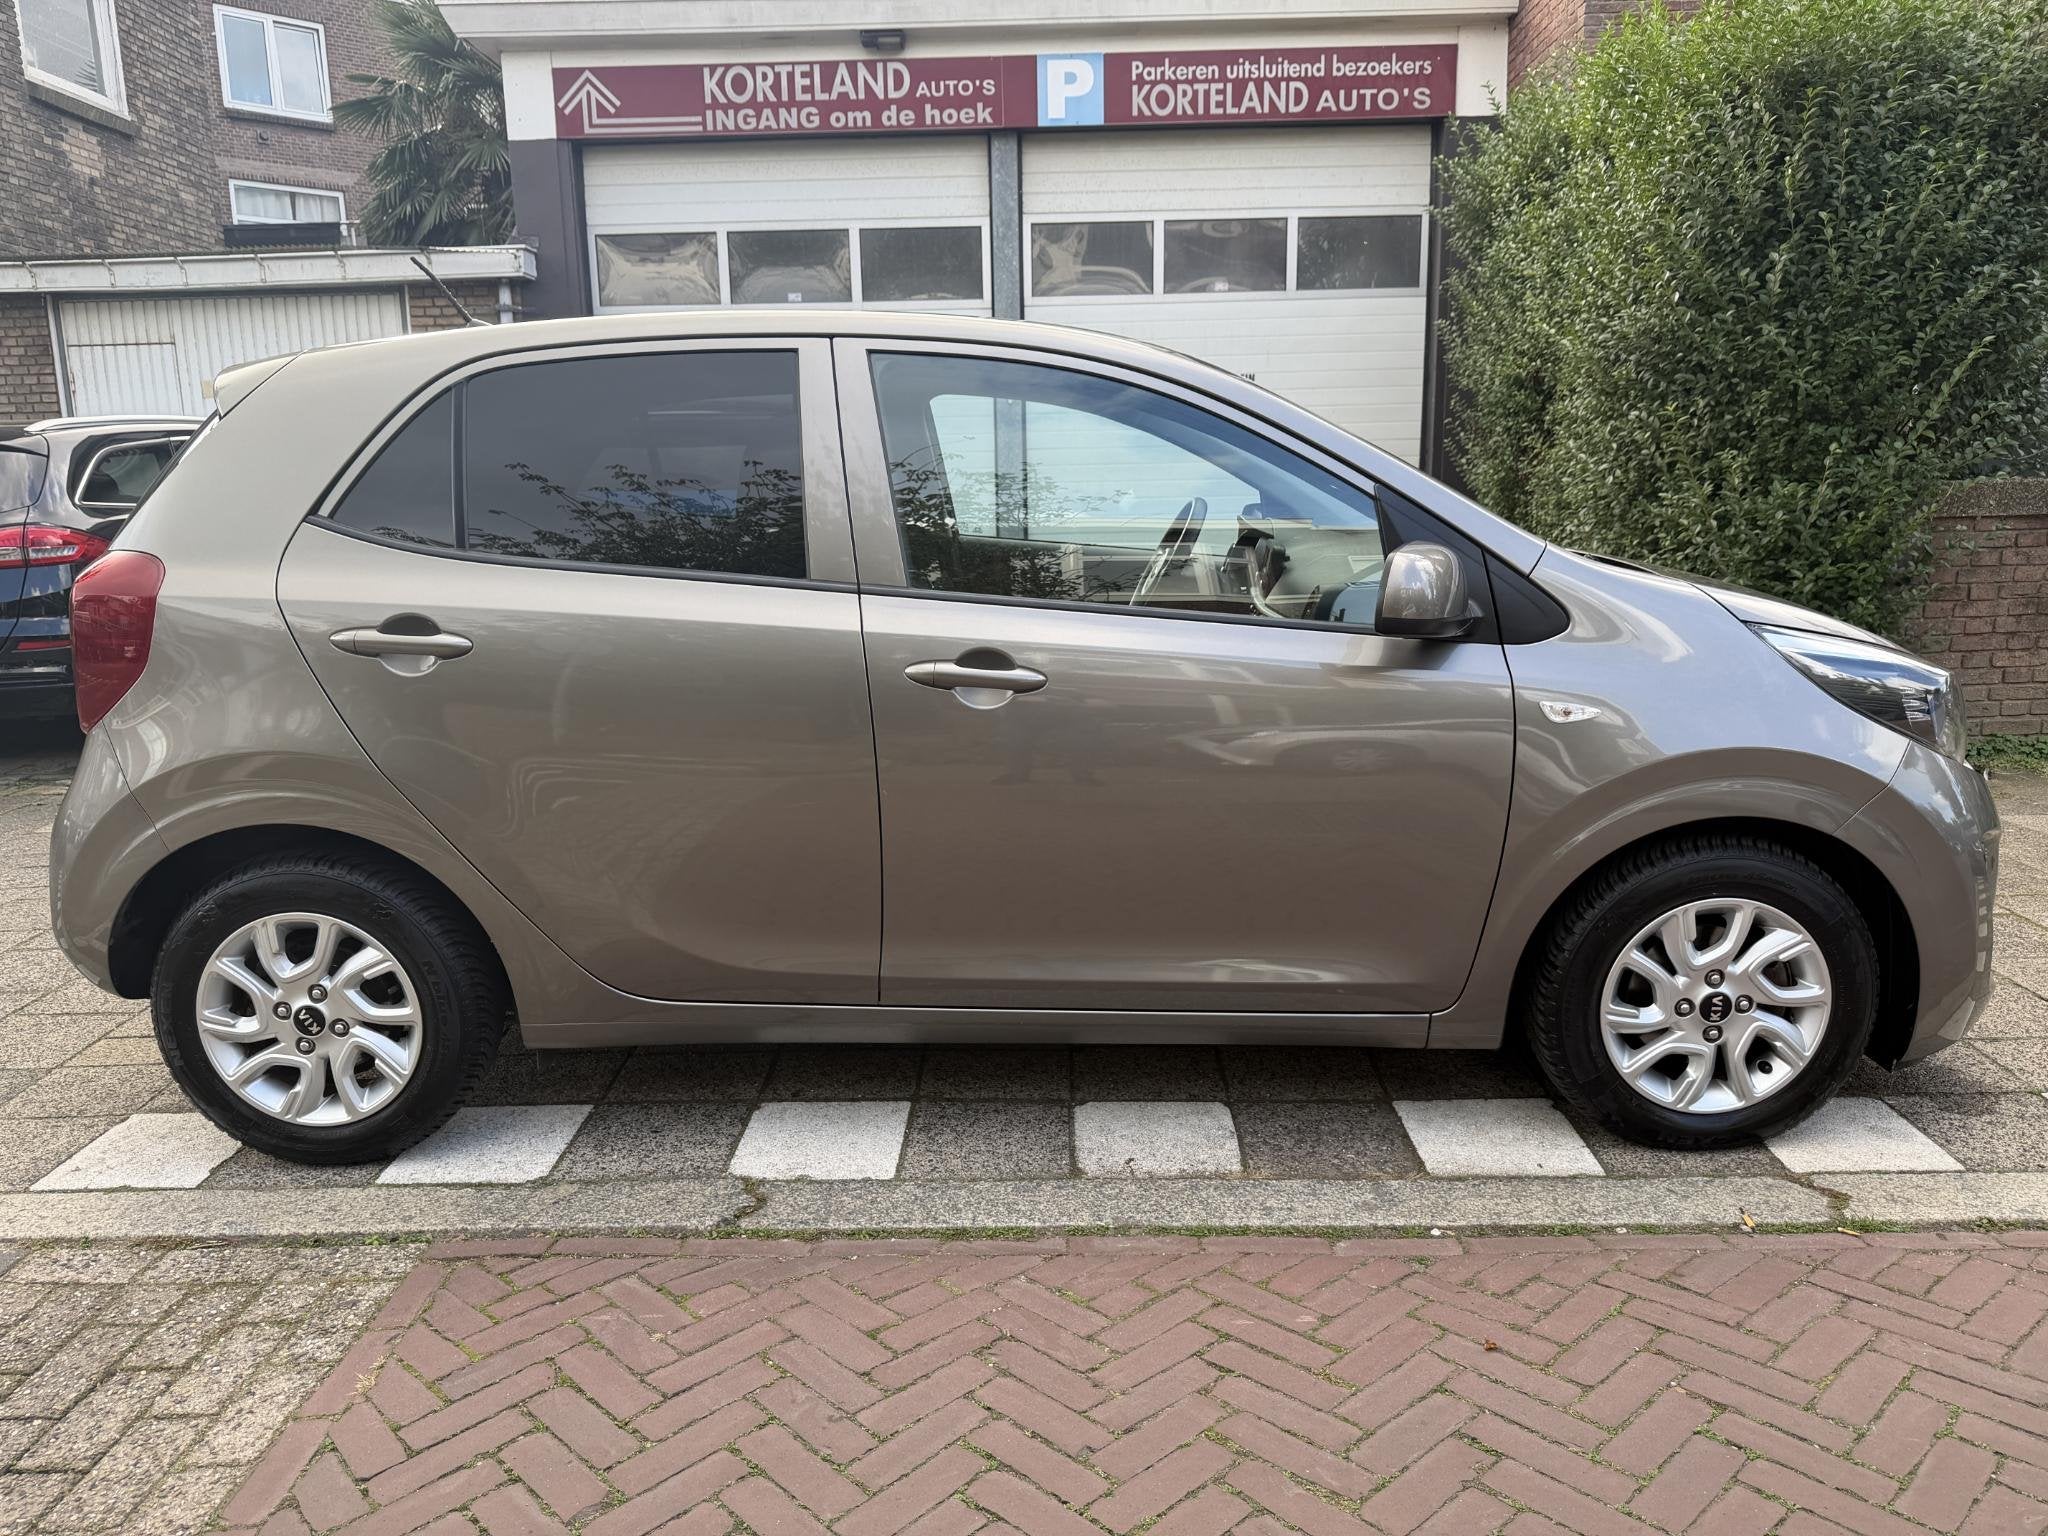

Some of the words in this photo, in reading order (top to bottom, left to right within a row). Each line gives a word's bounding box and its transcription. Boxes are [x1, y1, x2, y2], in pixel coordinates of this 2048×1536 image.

[1131, 57, 1219, 81] Parkeren
[1226, 54, 1325, 79] uitsluitend
[1332, 52, 1433, 76] bezoekers
[703, 61, 911, 104] KORTELAND
[915, 79, 996, 98] AUTO'S
[1046, 58, 1095, 119] P
[1131, 81, 1309, 117] KORTELAND
[1315, 87, 1432, 112] AUTO'S
[705, 106, 820, 131] INGANG
[829, 109, 872, 128] om
[881, 104, 916, 127] de
[924, 102, 994, 125] hoek
[298, 1008, 321, 1034] KIA
[1709, 995, 1724, 1021] KIA
